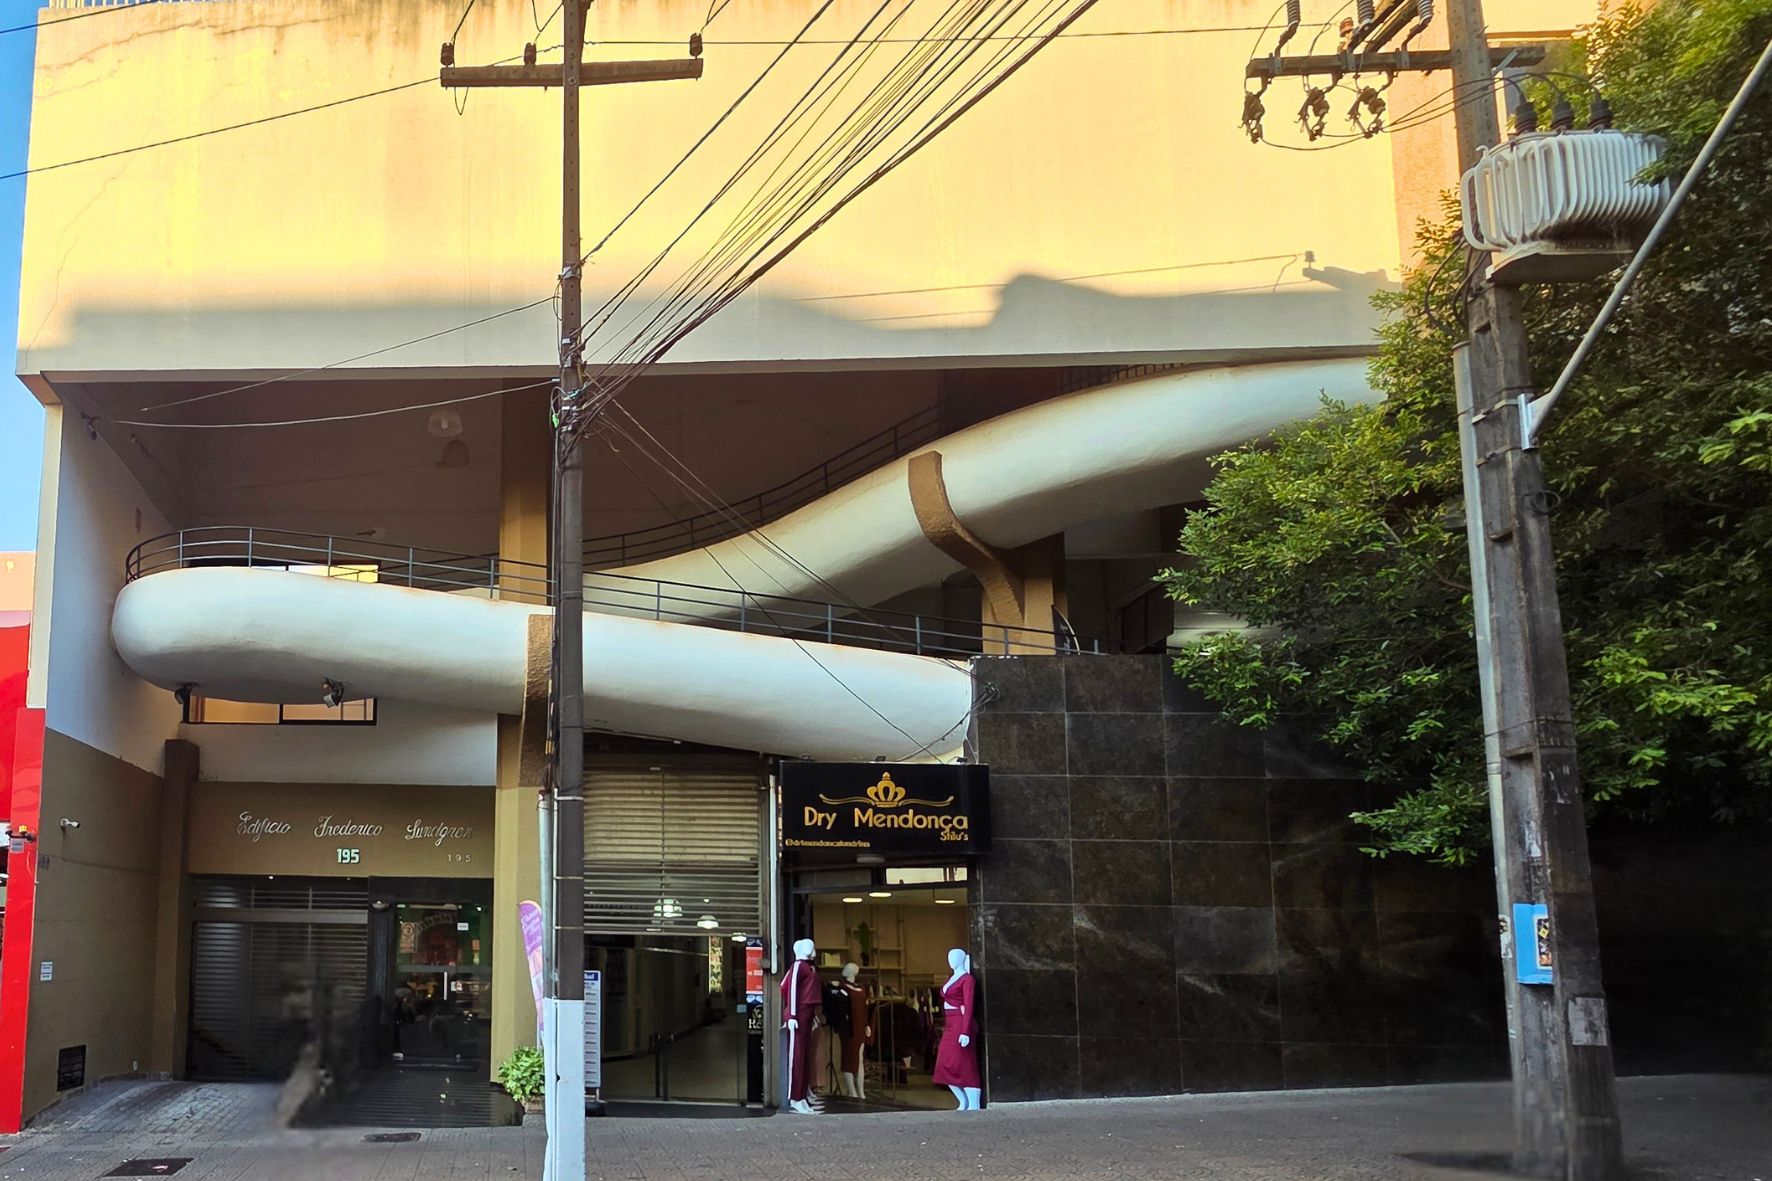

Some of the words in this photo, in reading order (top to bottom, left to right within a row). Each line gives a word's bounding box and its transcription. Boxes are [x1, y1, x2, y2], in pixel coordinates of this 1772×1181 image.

[314, 815, 383, 838] Frederico
[804, 806, 837, 830] Dry
[854, 808, 968, 832] Mendonça
[336, 848, 361, 864] 195
[447, 853, 472, 863] 195
